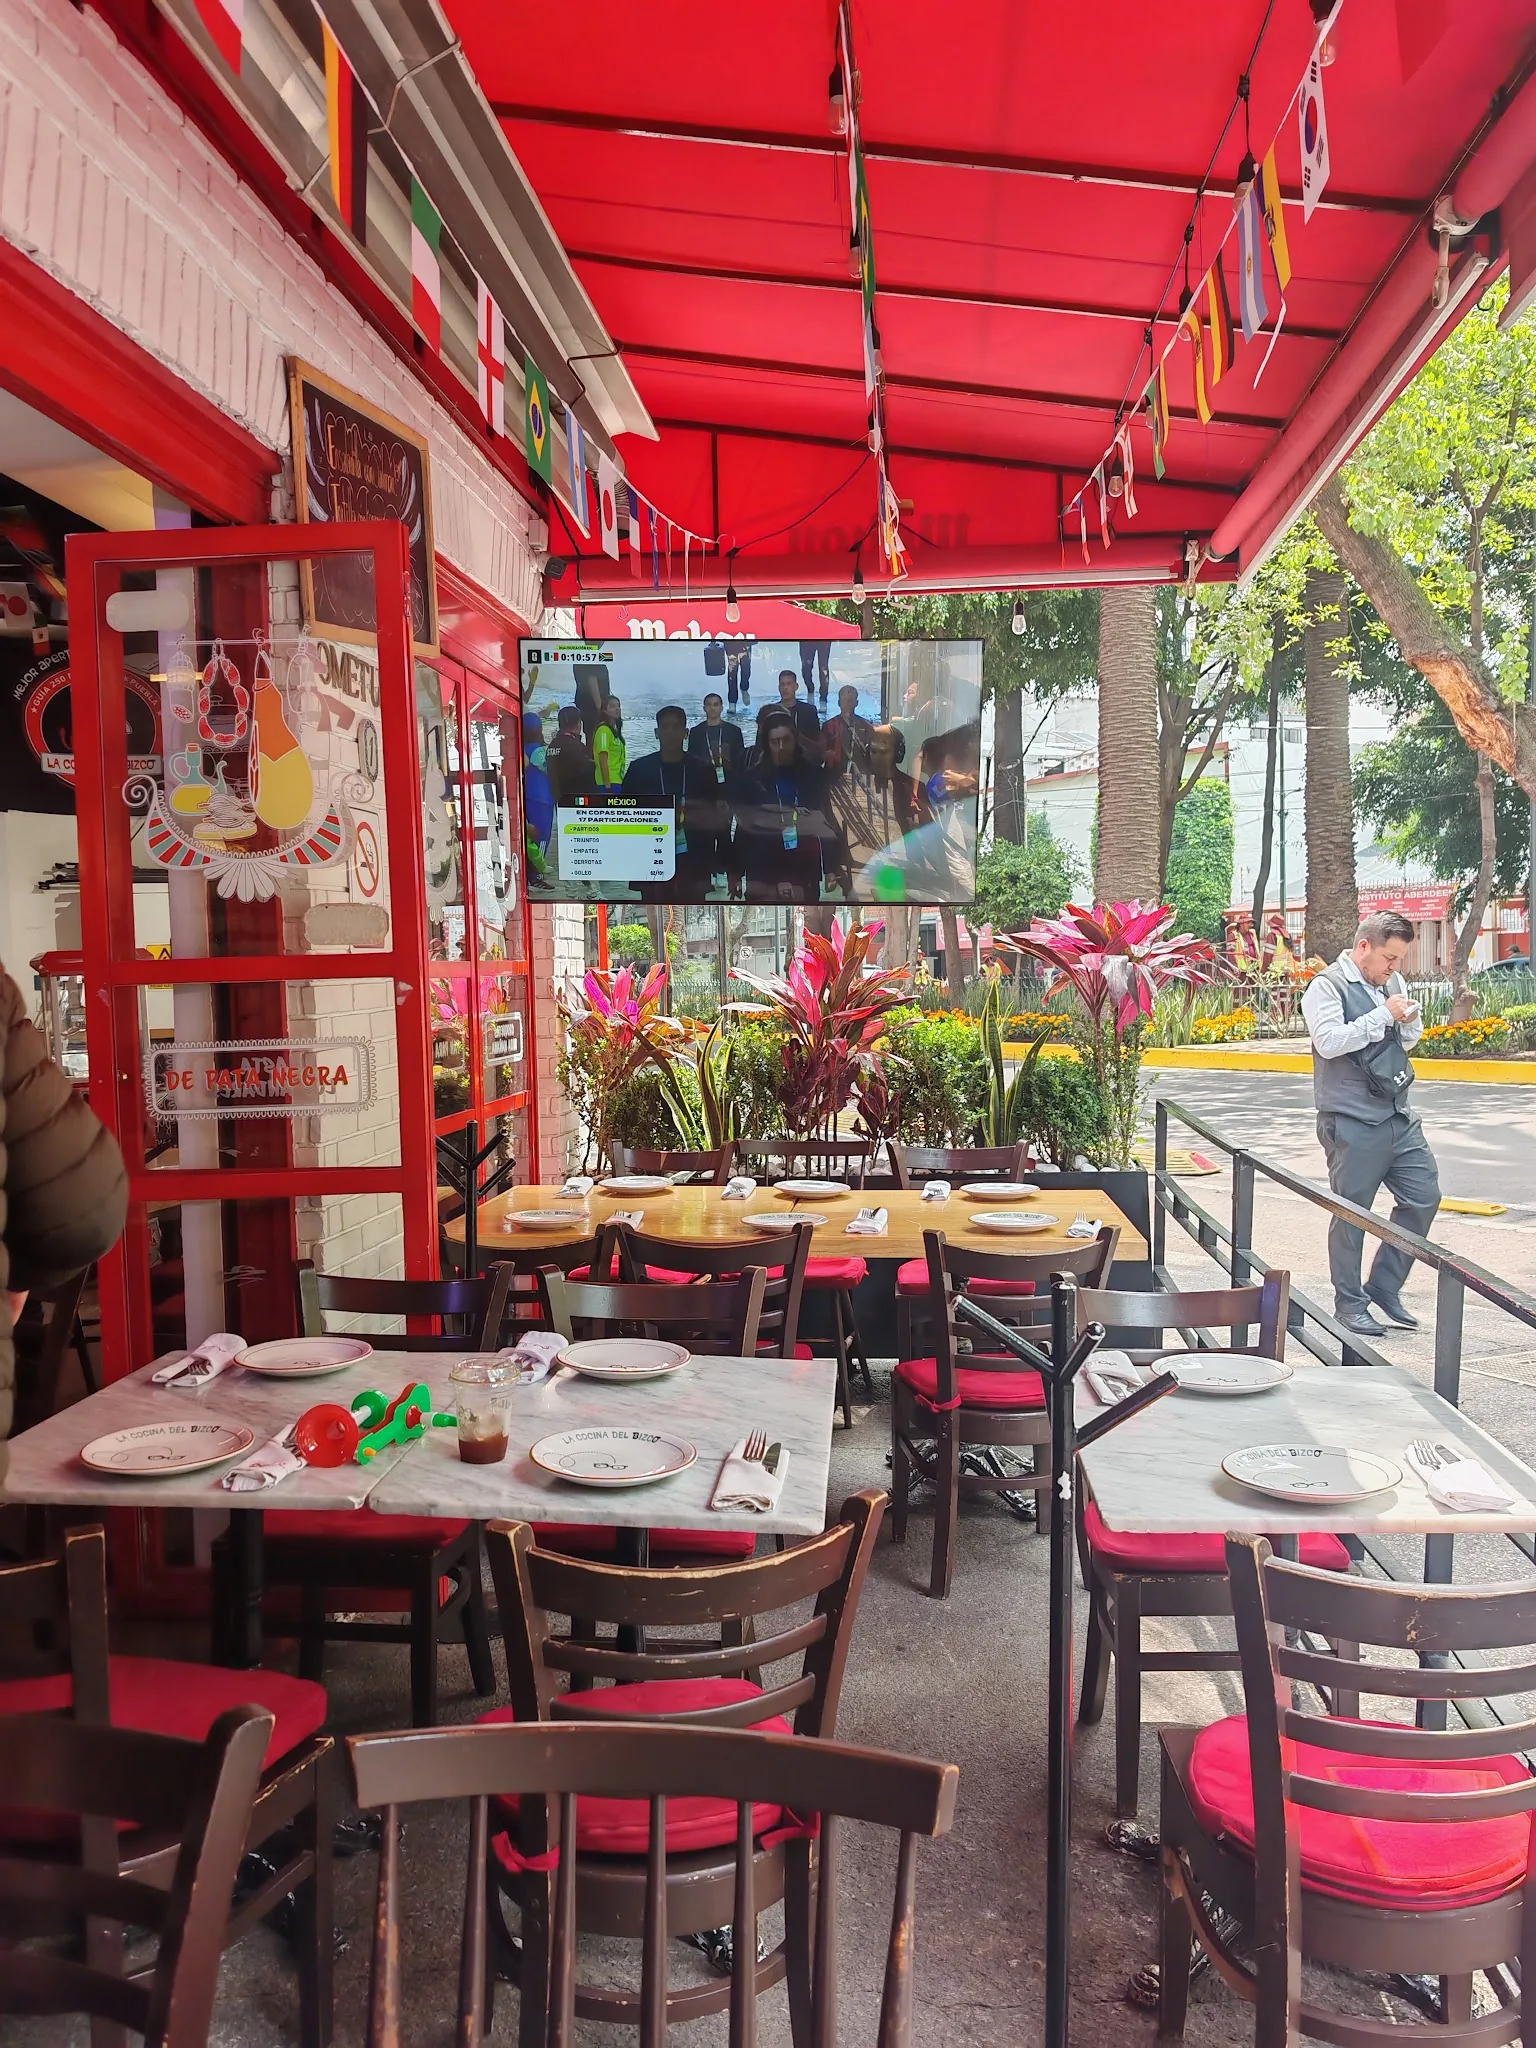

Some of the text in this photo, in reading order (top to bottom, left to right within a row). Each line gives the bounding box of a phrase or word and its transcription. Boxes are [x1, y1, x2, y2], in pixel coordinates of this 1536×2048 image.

[561, 653, 598, 661] 0:10:57
[50, 675, 66, 688] 250
[47, 758, 60, 769] LA
[607, 797, 637, 806] MÉXICO
[1358, 891, 1402, 901] NSTITUTO
[164, 1070, 194, 1091] DE
[204, 1068, 263, 1091] PATA
[272, 1064, 349, 1089] NEGRA
[116, 1425, 221, 1443] LA COCINA DEL BIZCO
[562, 1431, 661, 1445] LA COCINA DEL BIZCO
[1288, 1448, 1323, 1458] BIZCO
